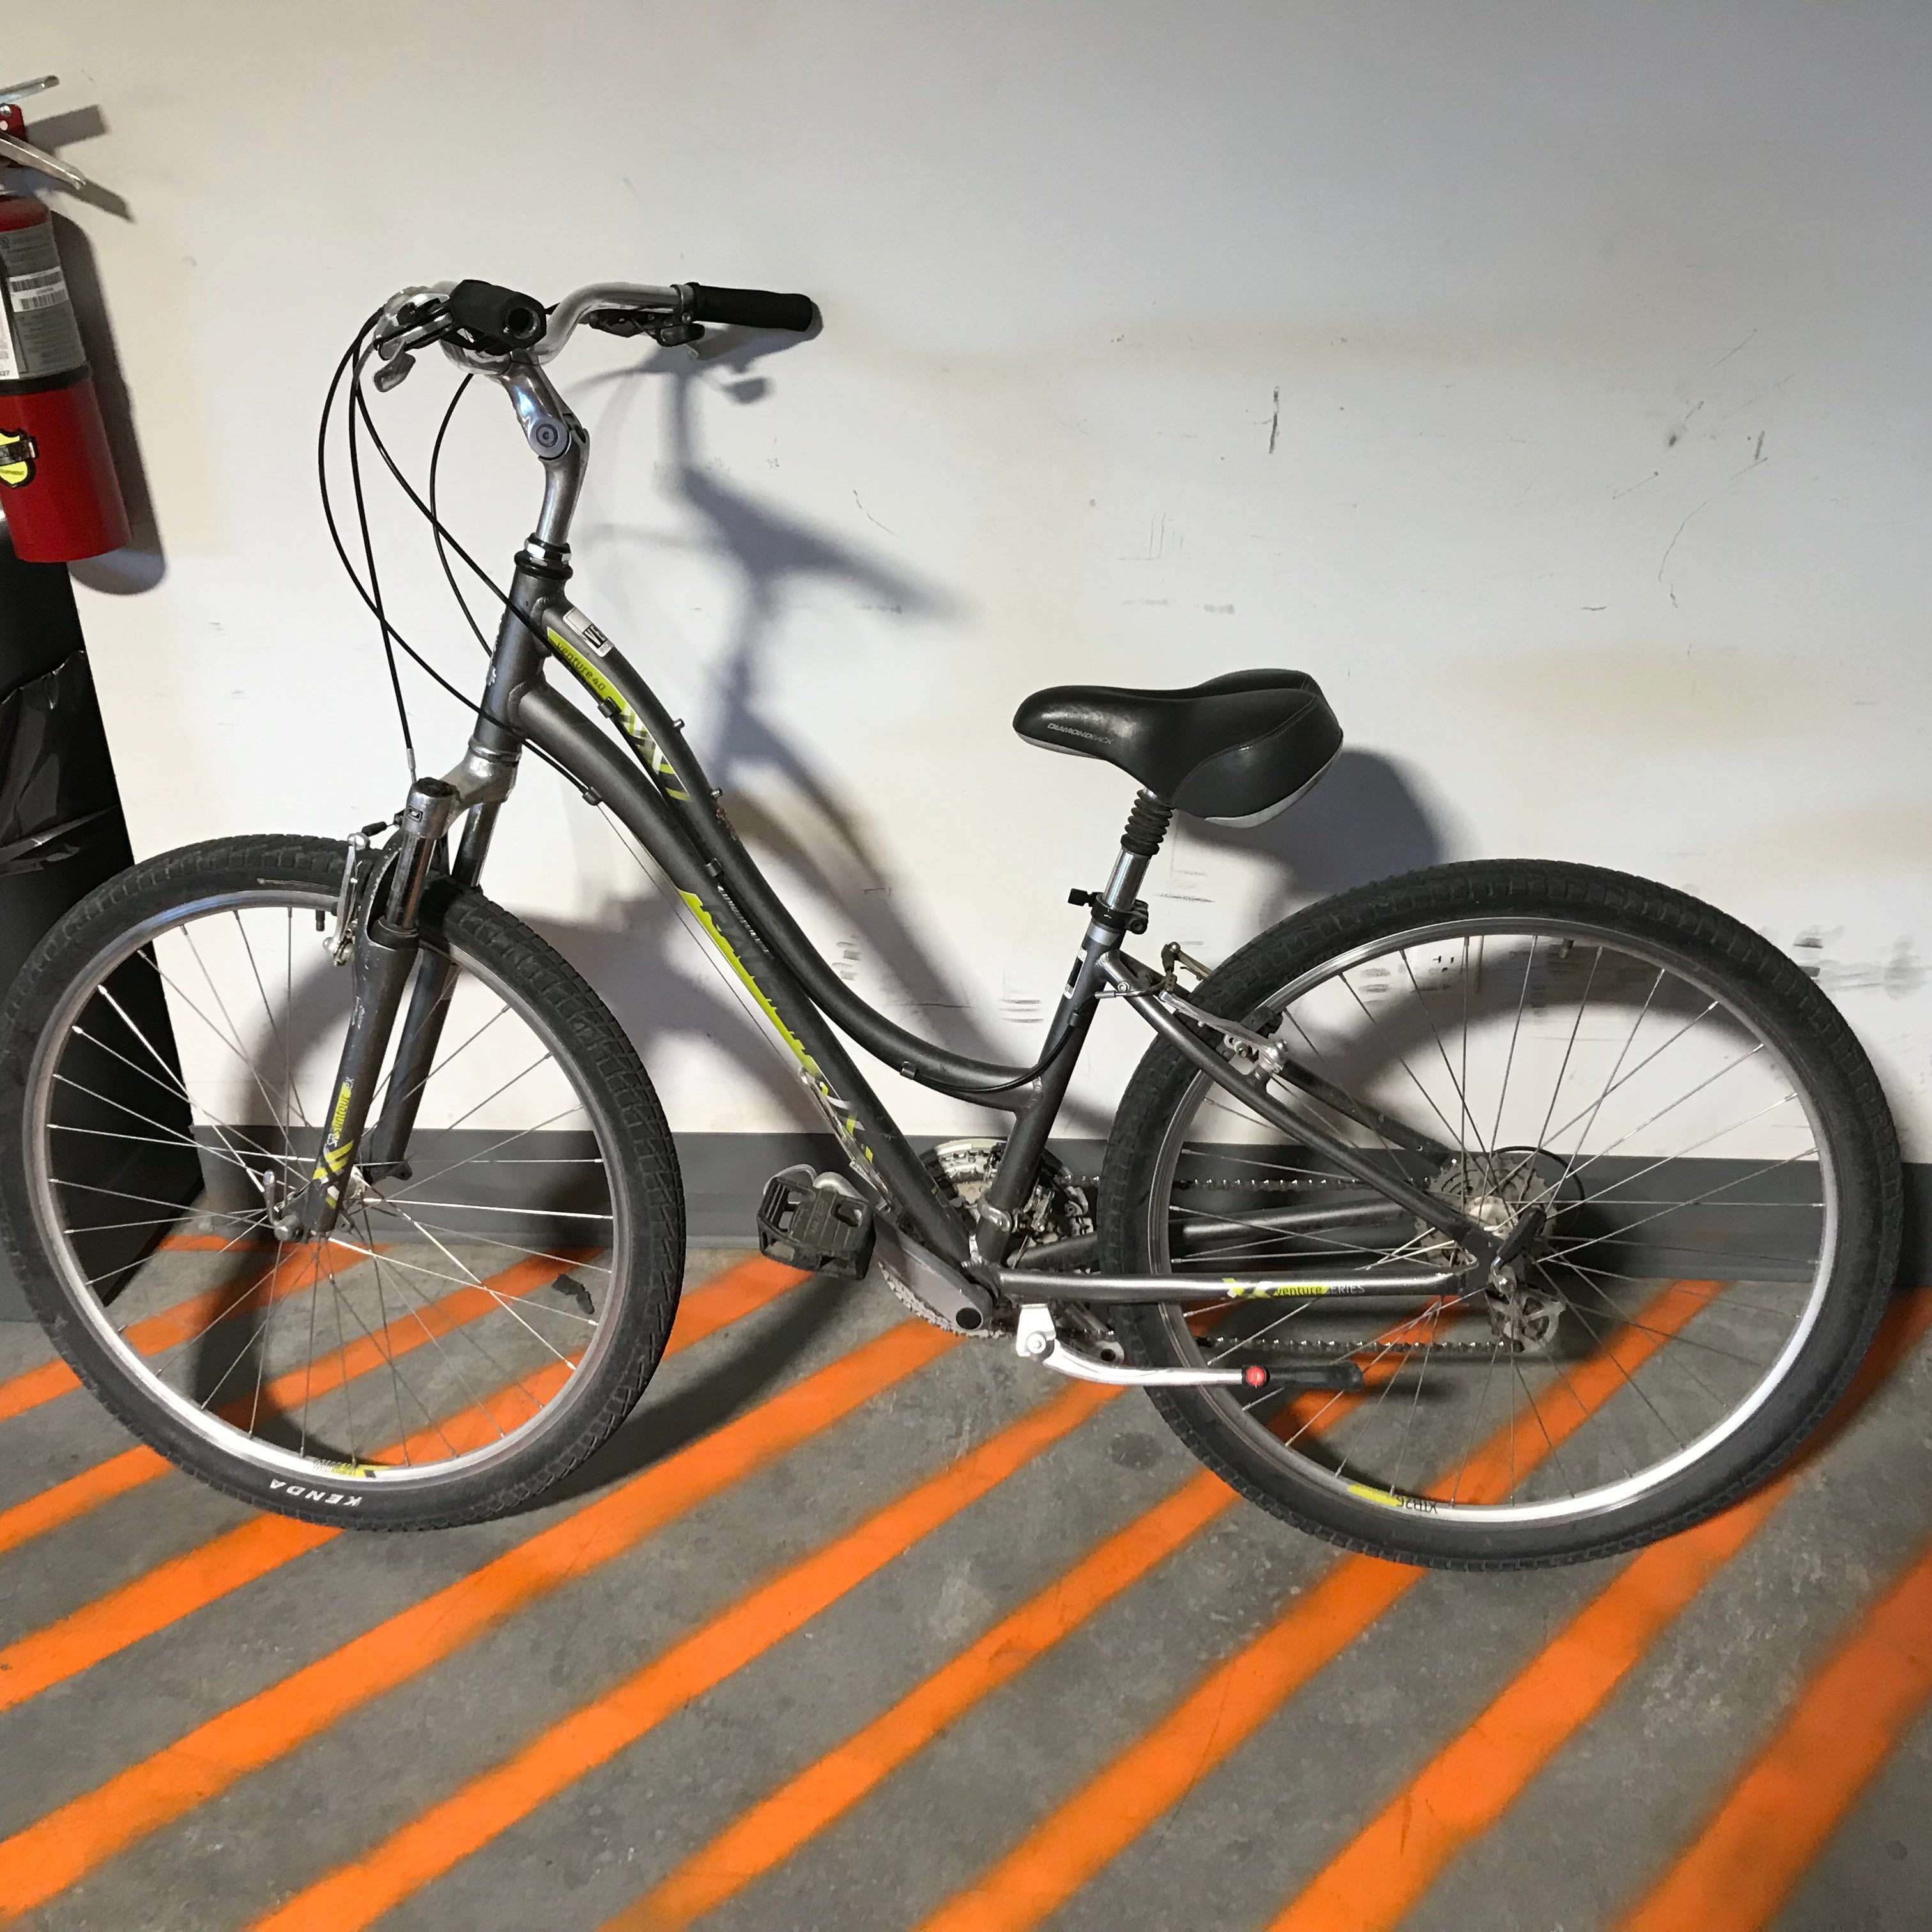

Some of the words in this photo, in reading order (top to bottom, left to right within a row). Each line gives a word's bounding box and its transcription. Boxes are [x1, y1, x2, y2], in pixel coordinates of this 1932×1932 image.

[556, 641, 594, 679] venture
[1276, 1285, 1322, 1296] venture
[270, 1478, 363, 1507] KENDA
